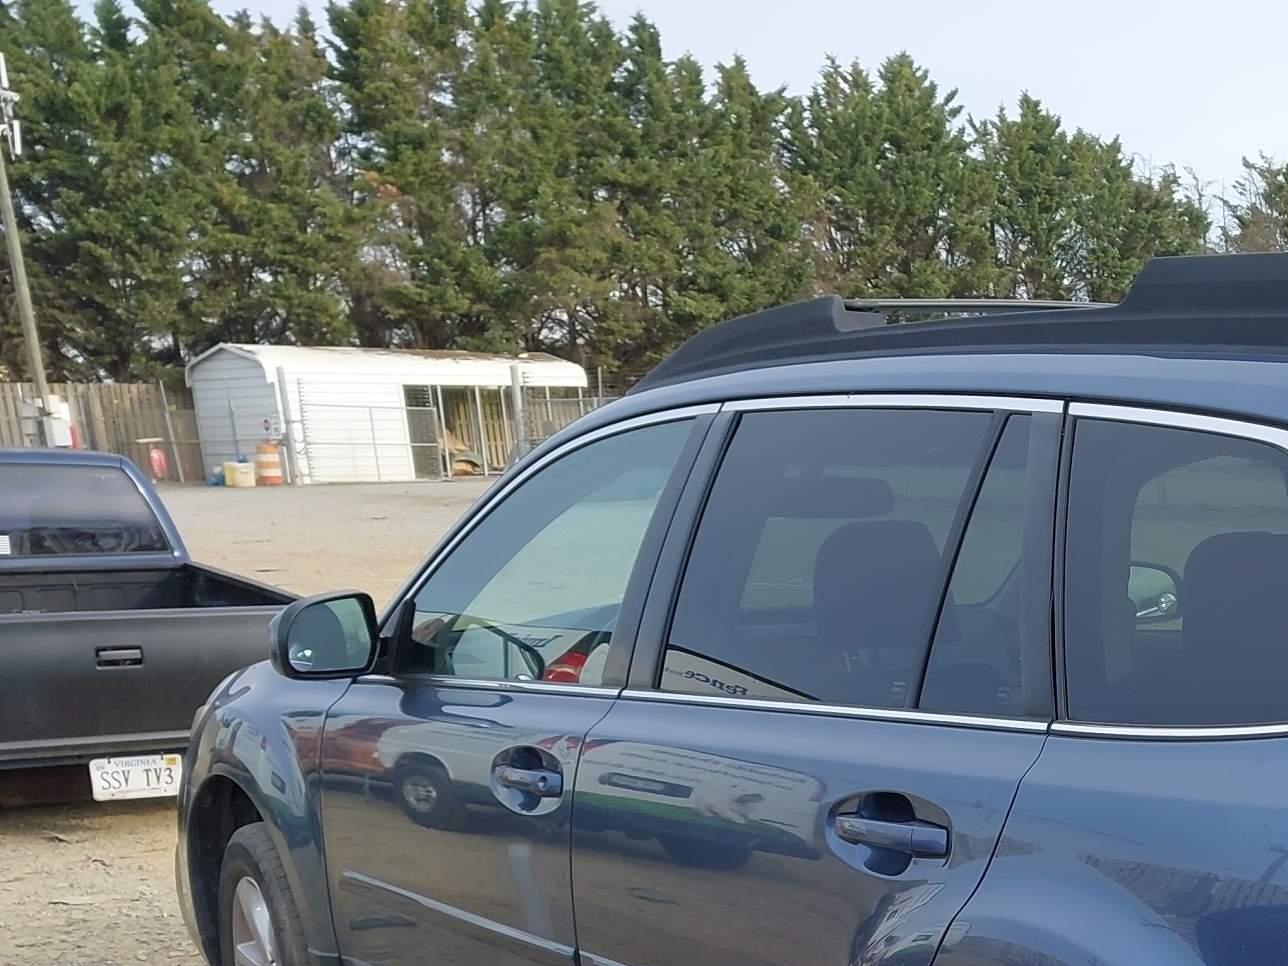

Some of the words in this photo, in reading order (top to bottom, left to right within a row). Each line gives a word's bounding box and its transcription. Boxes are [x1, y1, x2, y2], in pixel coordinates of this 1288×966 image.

[114, 759, 157, 768] VIRGINIA
[101, 769, 130, 790] SSV
[143, 767, 174, 787] TV3
